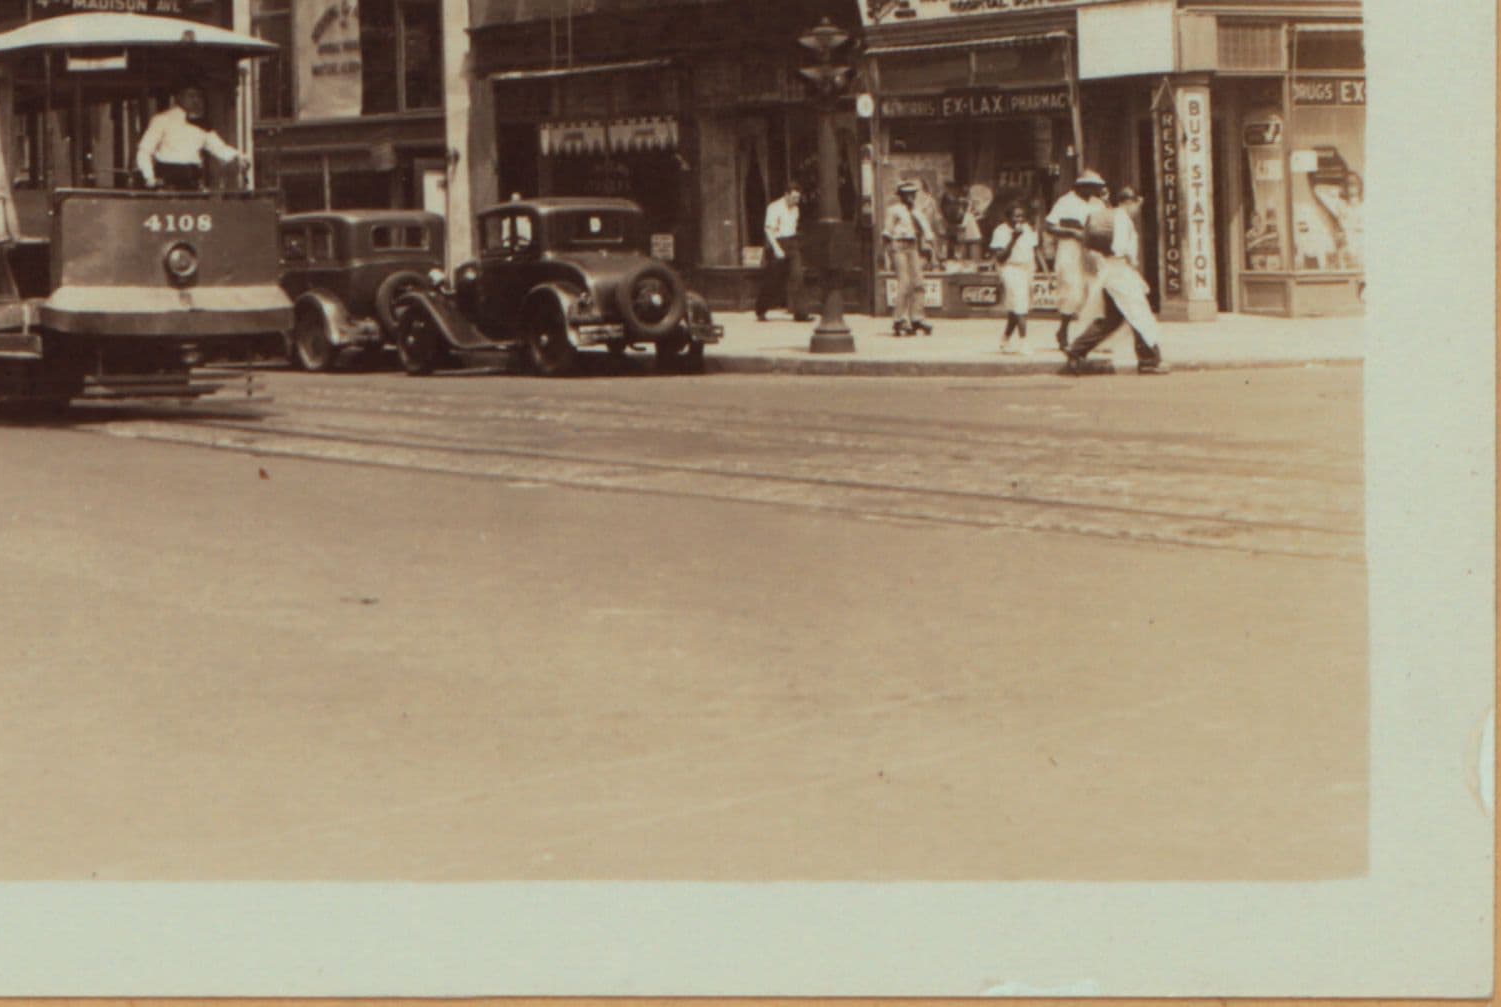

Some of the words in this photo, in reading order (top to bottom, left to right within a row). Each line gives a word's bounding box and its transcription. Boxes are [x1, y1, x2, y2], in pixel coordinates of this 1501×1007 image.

[942, 95, 1003, 117] EX-LAX
[1188, 100, 1201, 153] BUS
[143, 214, 212, 232] 4108
[1191, 165, 1207, 289] STATION
